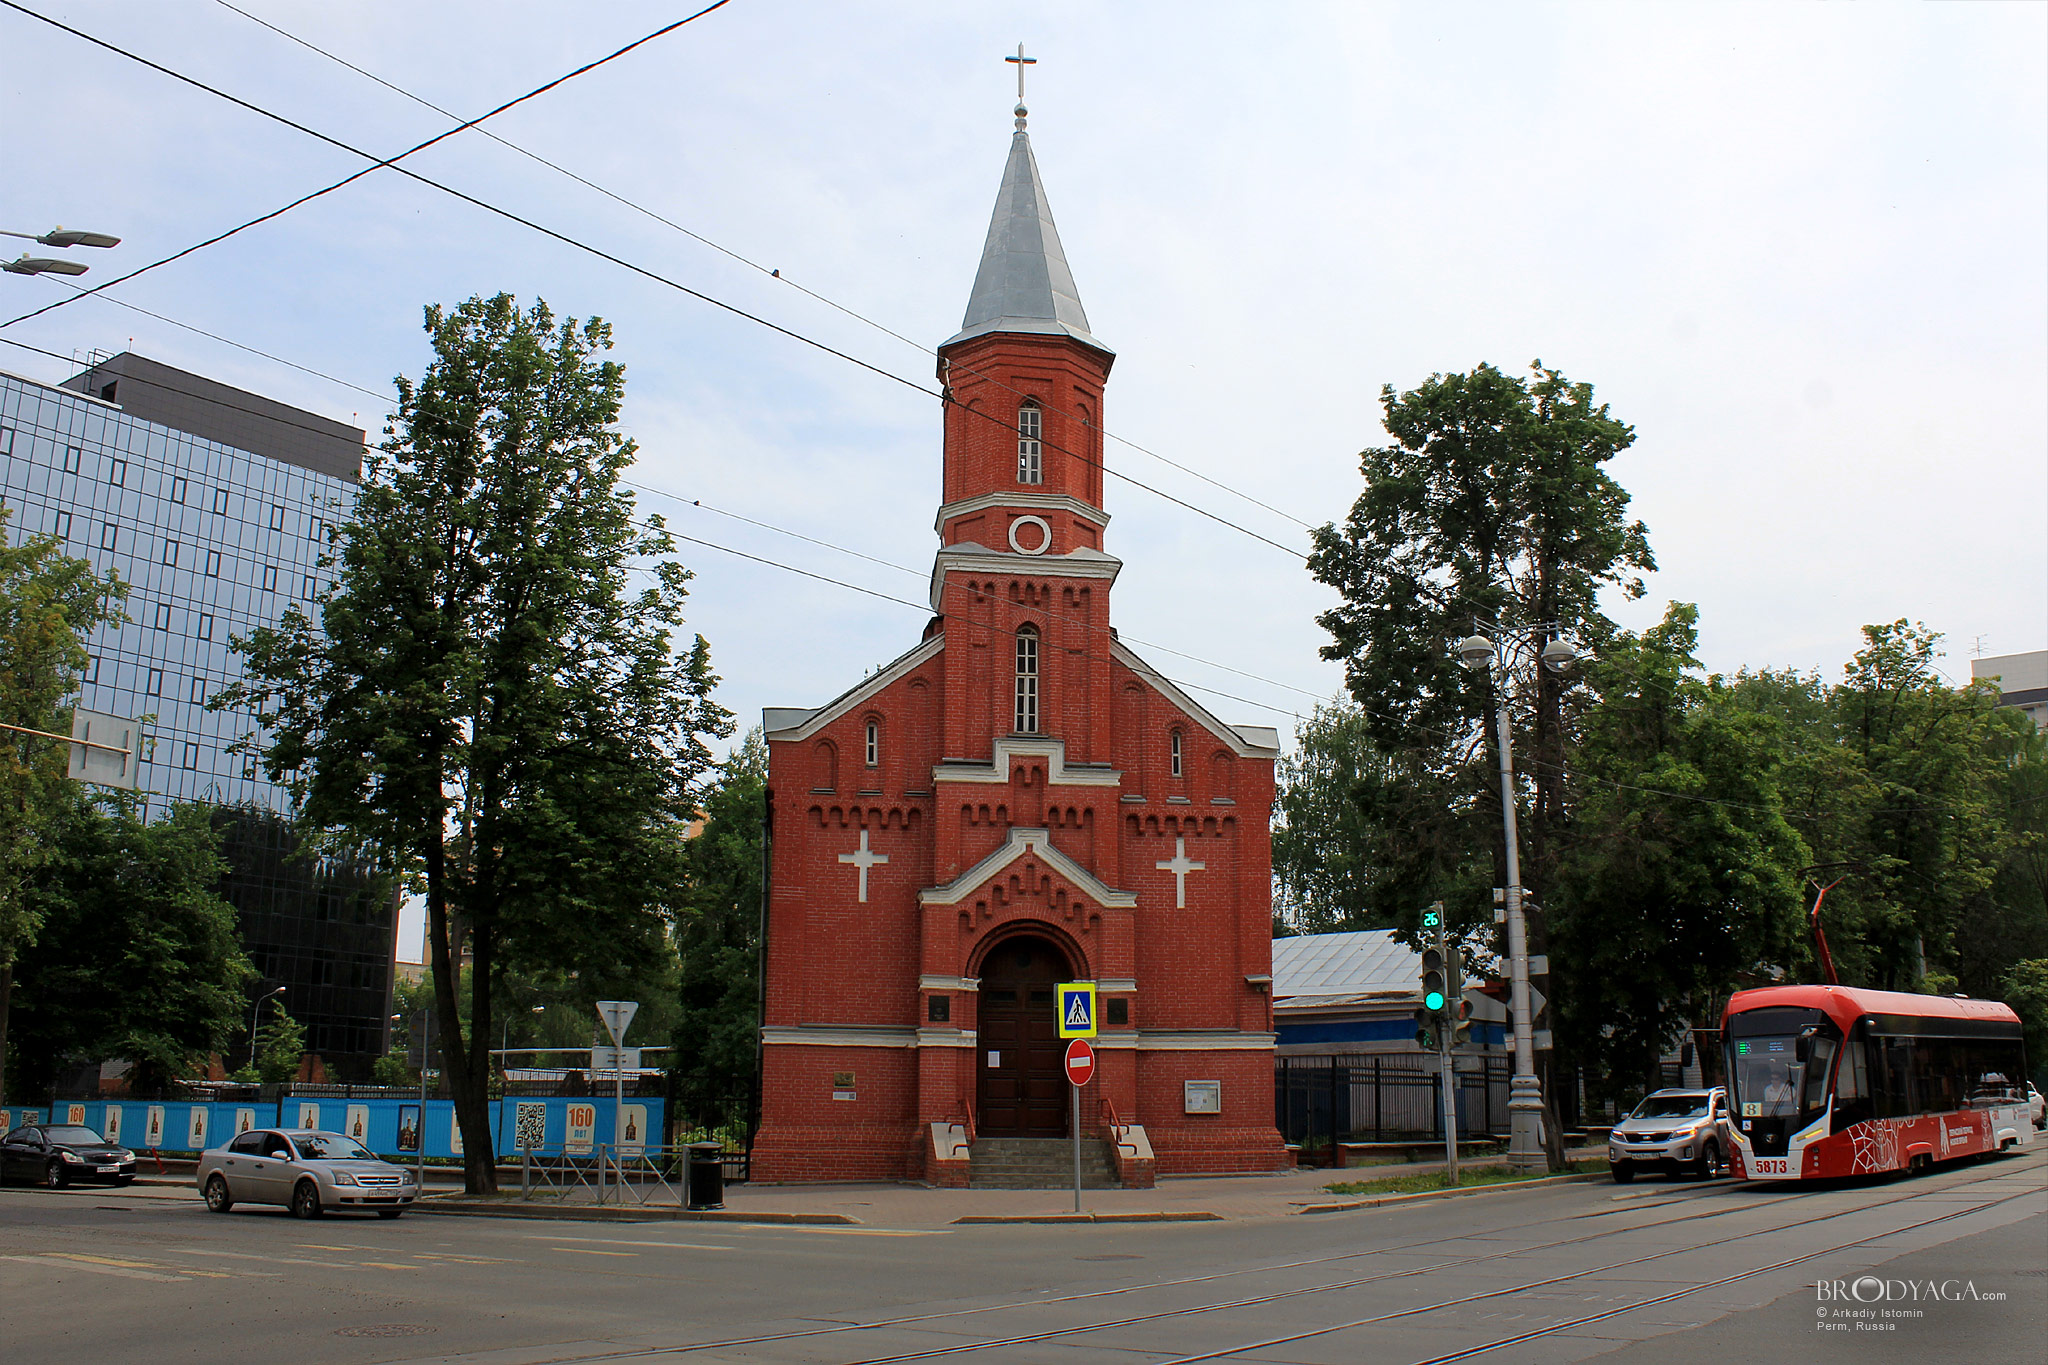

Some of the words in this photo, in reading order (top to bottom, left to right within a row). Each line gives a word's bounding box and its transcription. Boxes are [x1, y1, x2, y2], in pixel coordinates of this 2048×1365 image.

[1423, 912, 1439, 927] 26
[69, 1107, 85, 1122] 160
[568, 1107, 593, 1127] 160
[1746, 1103, 1757, 1116] 8
[1755, 1160, 1788, 1174] 5873
